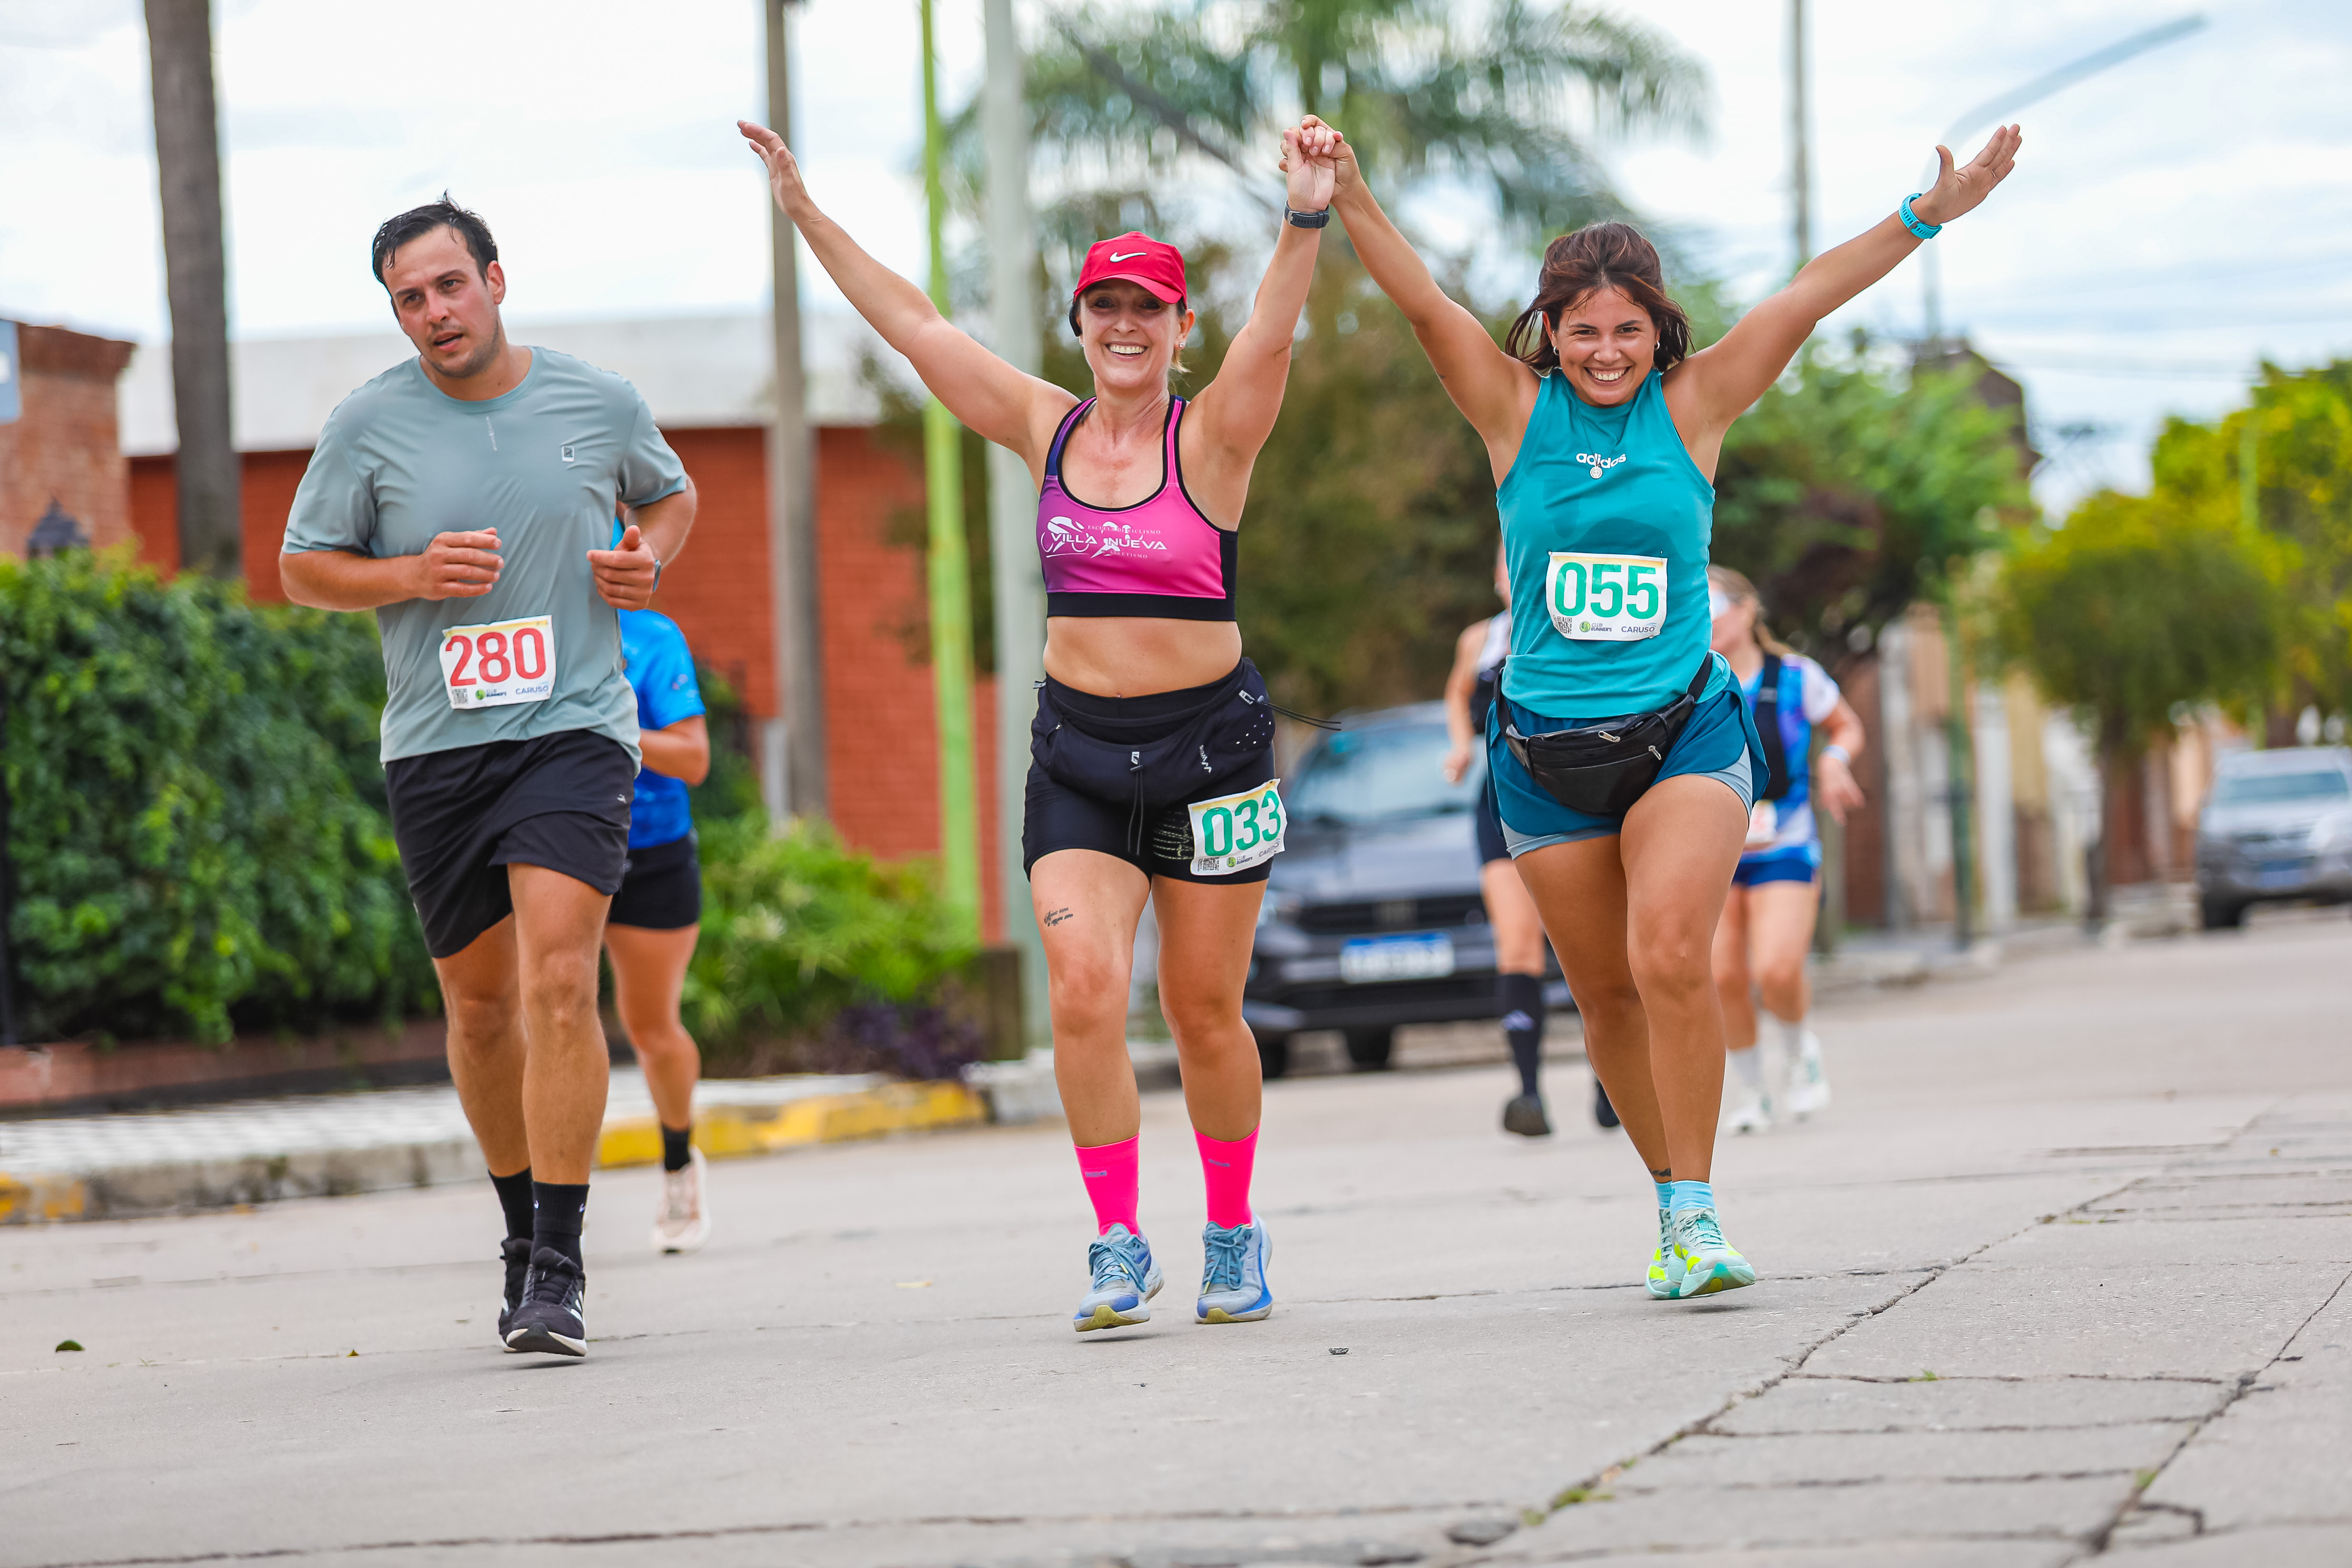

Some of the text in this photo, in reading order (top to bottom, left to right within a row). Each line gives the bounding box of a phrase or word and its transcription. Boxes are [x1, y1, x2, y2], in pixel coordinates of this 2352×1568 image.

[1576, 453, 1626, 468] adidas
[1051, 533, 1168, 550] VILLA NUEVA
[1555, 562, 1659, 619] 055
[445, 628, 546, 687] 280
[515, 685, 549, 695] CARUSO
[1202, 790, 1281, 857] 033
